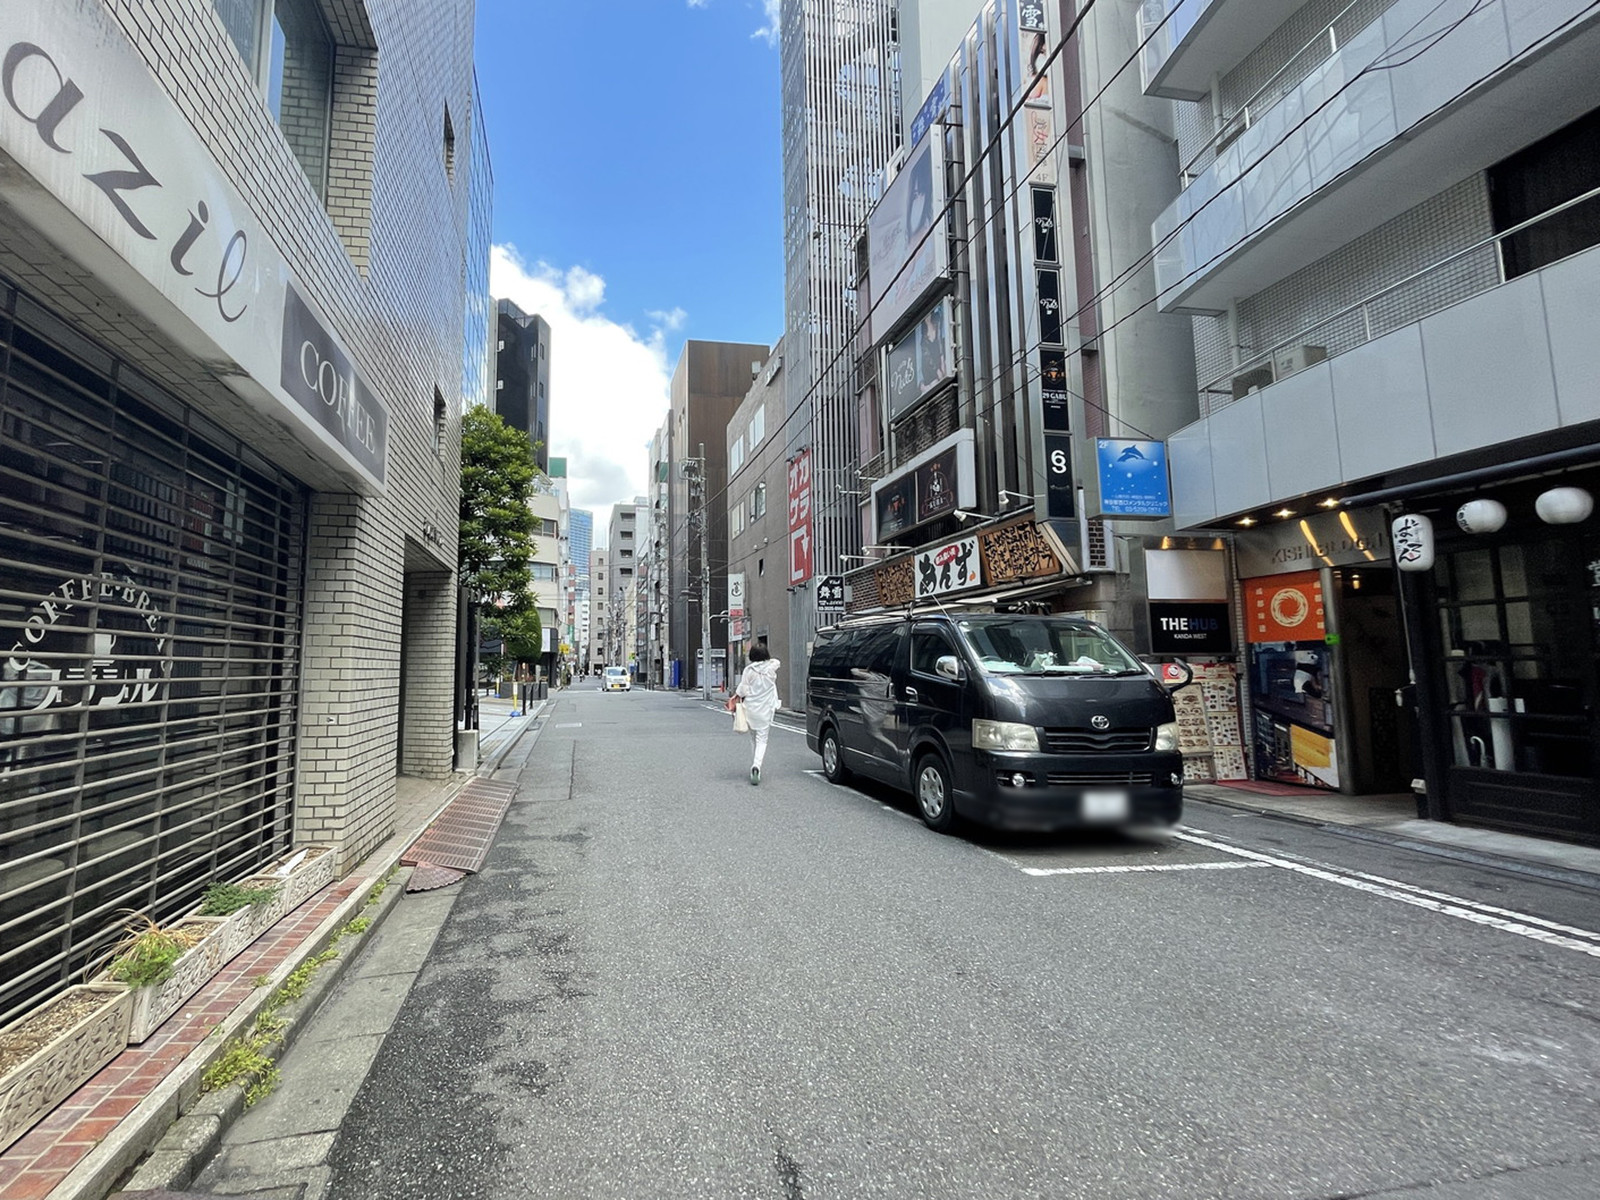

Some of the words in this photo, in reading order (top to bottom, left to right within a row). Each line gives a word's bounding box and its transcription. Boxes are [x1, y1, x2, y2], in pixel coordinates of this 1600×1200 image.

[1021, 4, 1042, 27] 雪
[301, 340, 375, 454] COFFEE
[1160, 617, 1189, 631] THE
[1189, 617, 1219, 631] HUB
